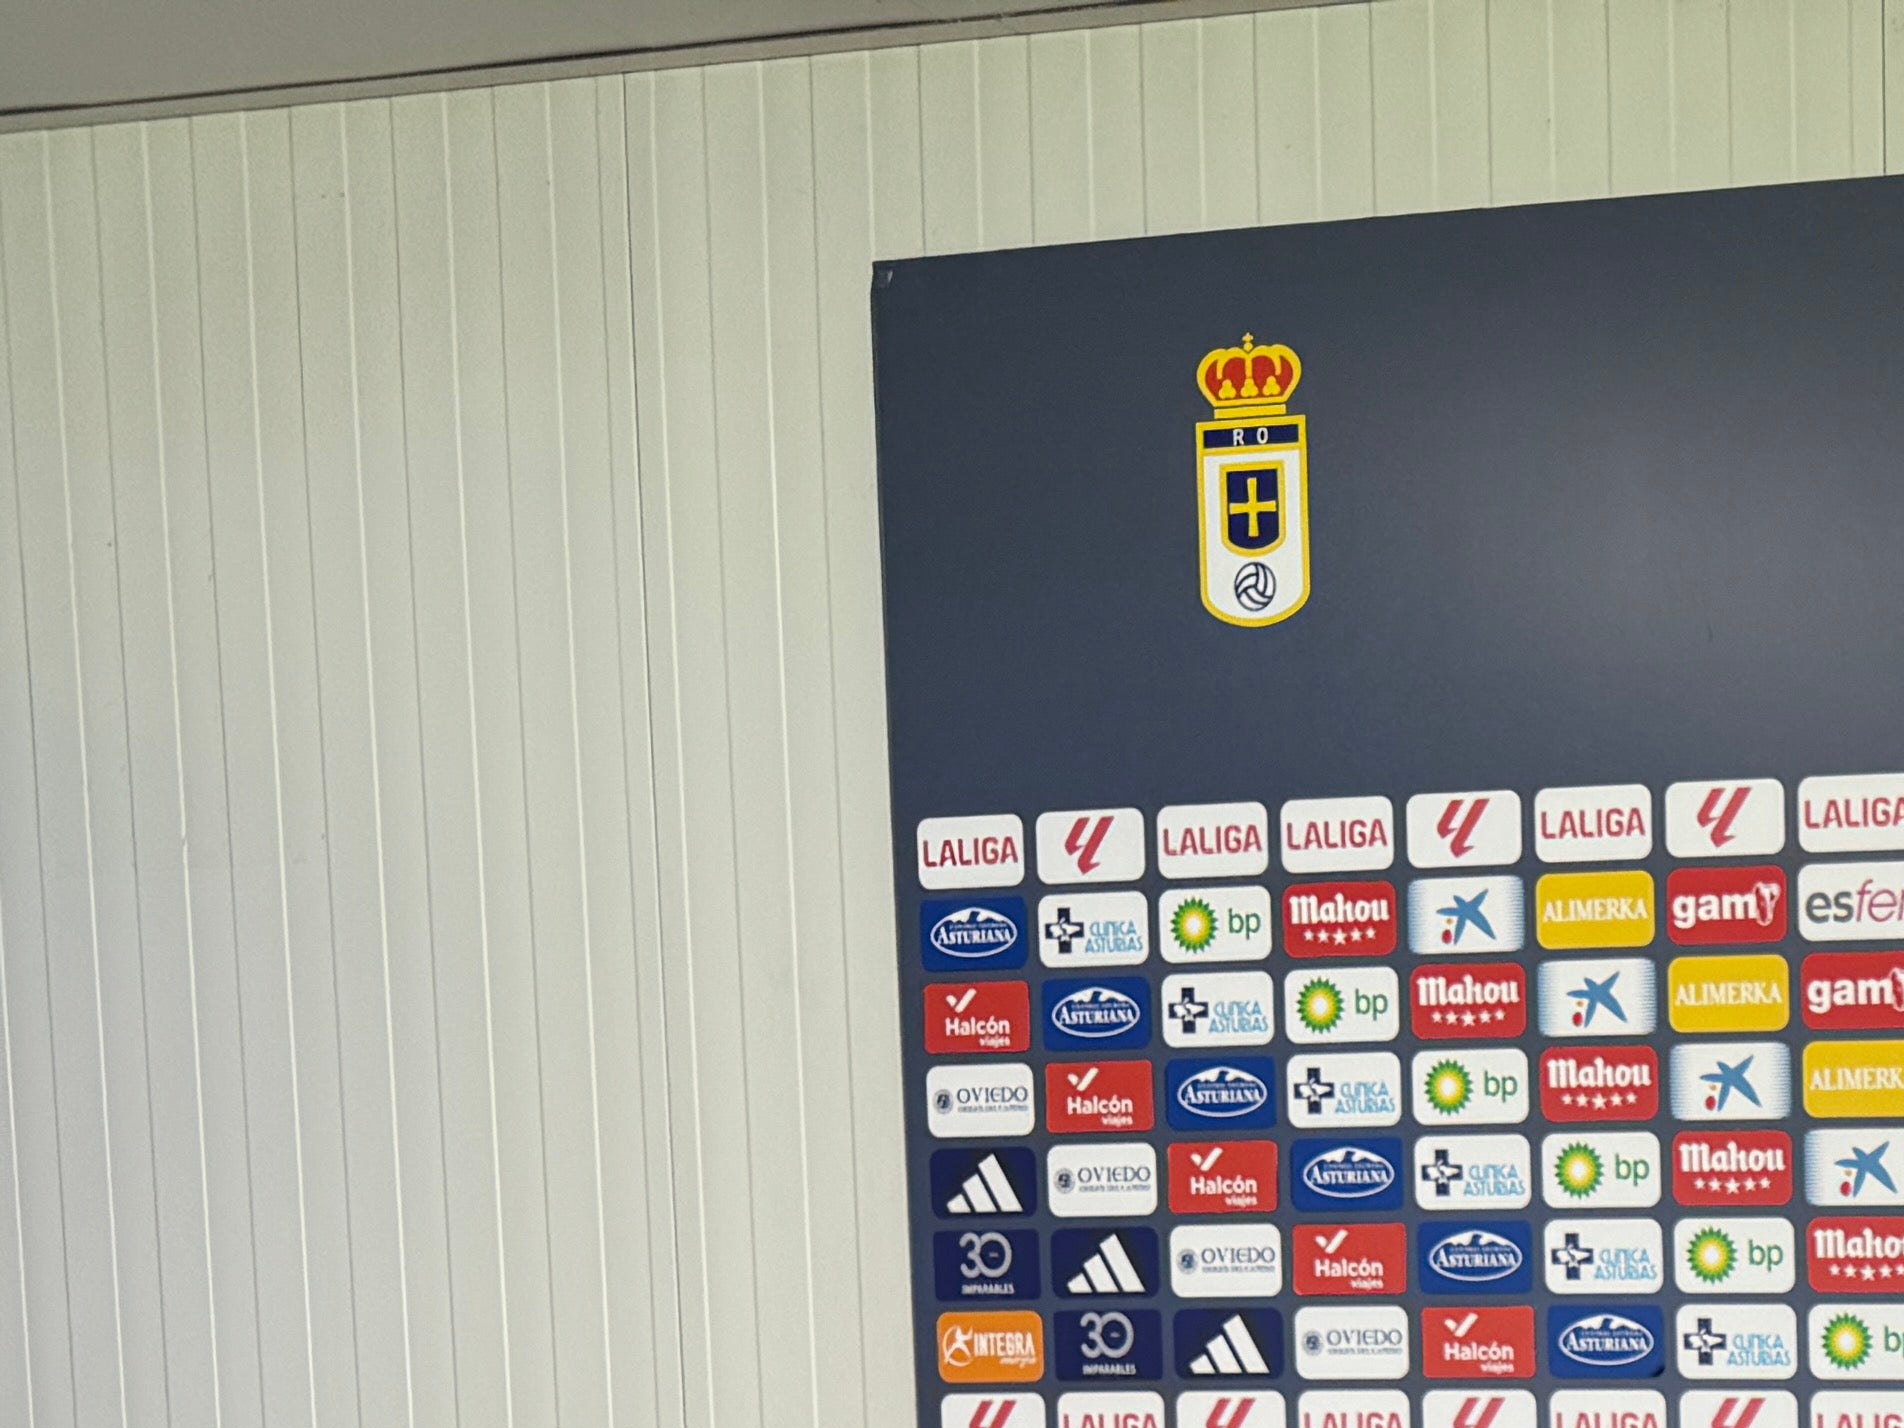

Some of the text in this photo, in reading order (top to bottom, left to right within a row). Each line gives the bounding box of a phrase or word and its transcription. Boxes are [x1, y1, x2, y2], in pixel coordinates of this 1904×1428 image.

[923, 836, 1018, 867] LALIGA
[1228, 907, 1261, 939] bp
[1415, 972, 1520, 1007] Mahou
